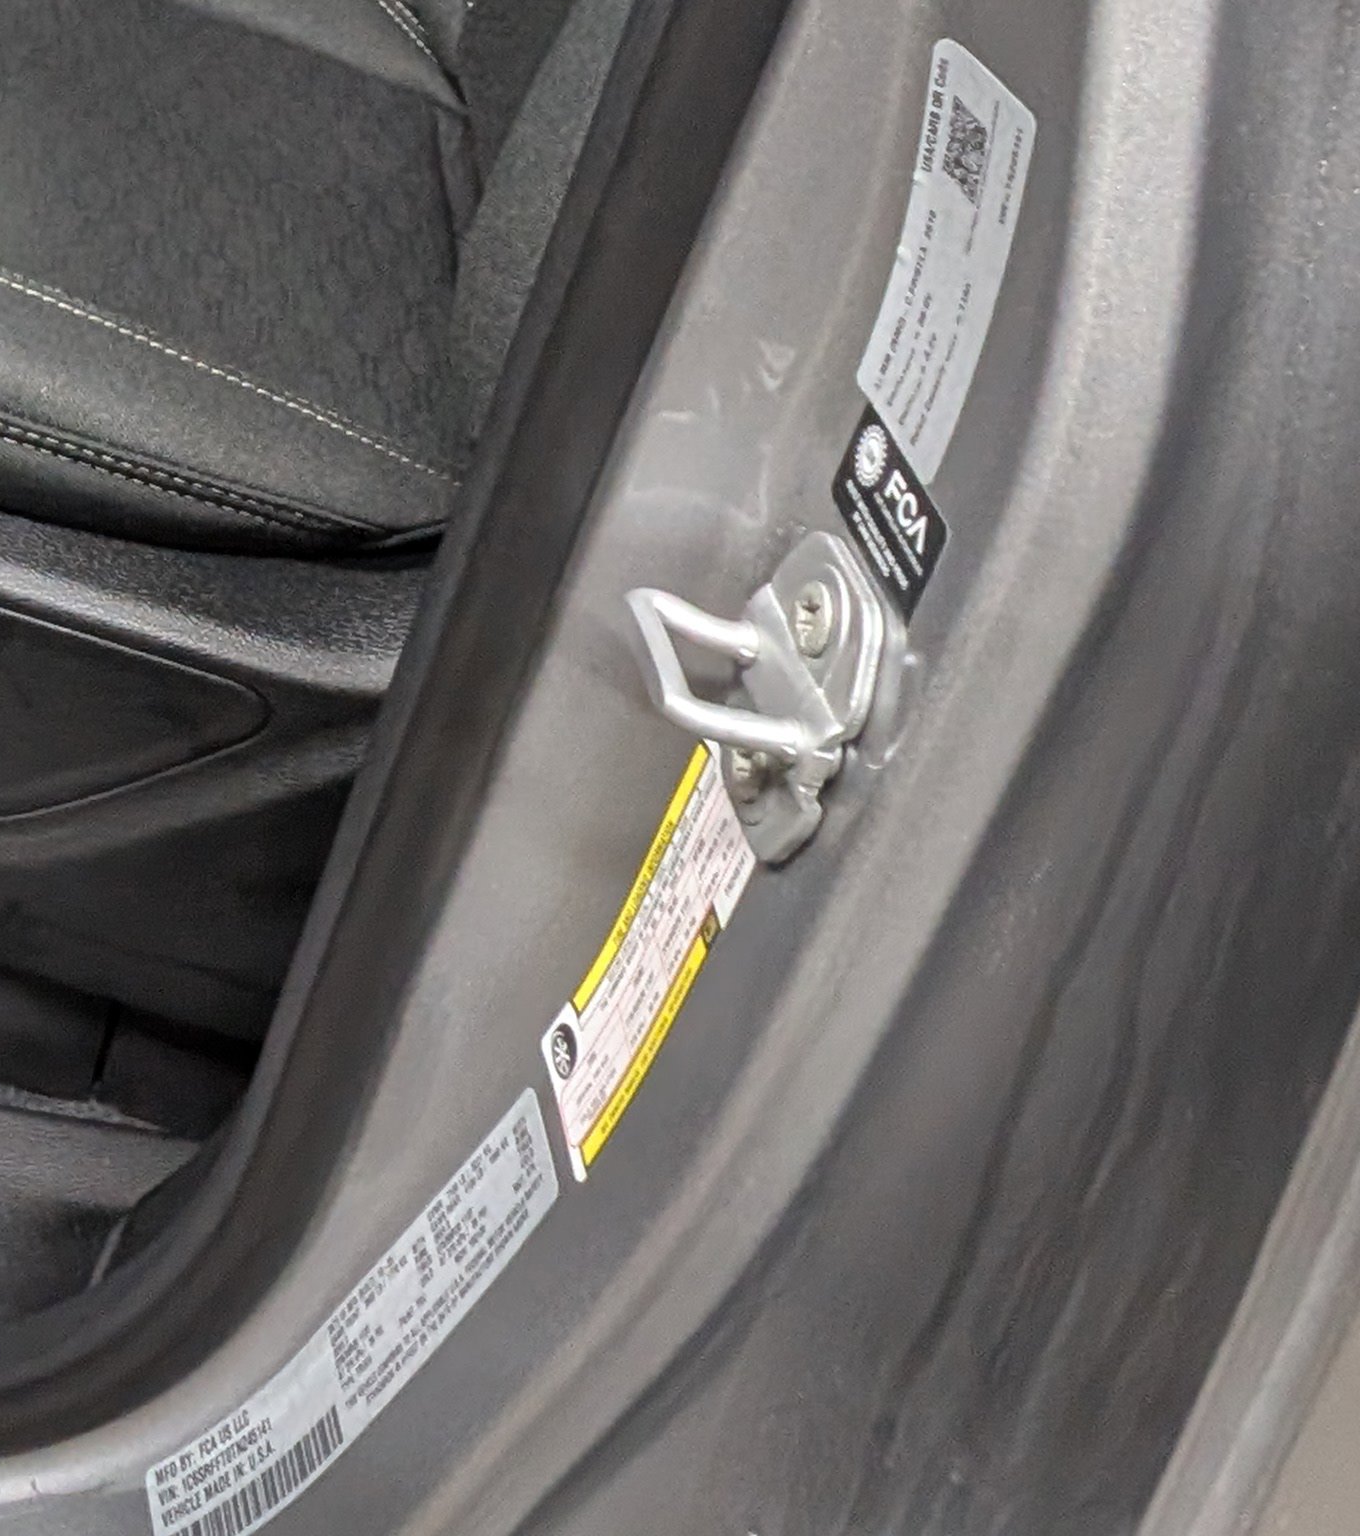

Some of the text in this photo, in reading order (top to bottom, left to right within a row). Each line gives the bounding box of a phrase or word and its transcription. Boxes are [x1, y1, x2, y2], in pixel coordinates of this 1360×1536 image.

[884, 469, 928, 555] FCA
[198, 1435, 218, 1458] FCA
[232, 1409, 249, 1434] LLC
[203, 1471, 232, 1502] MADE
